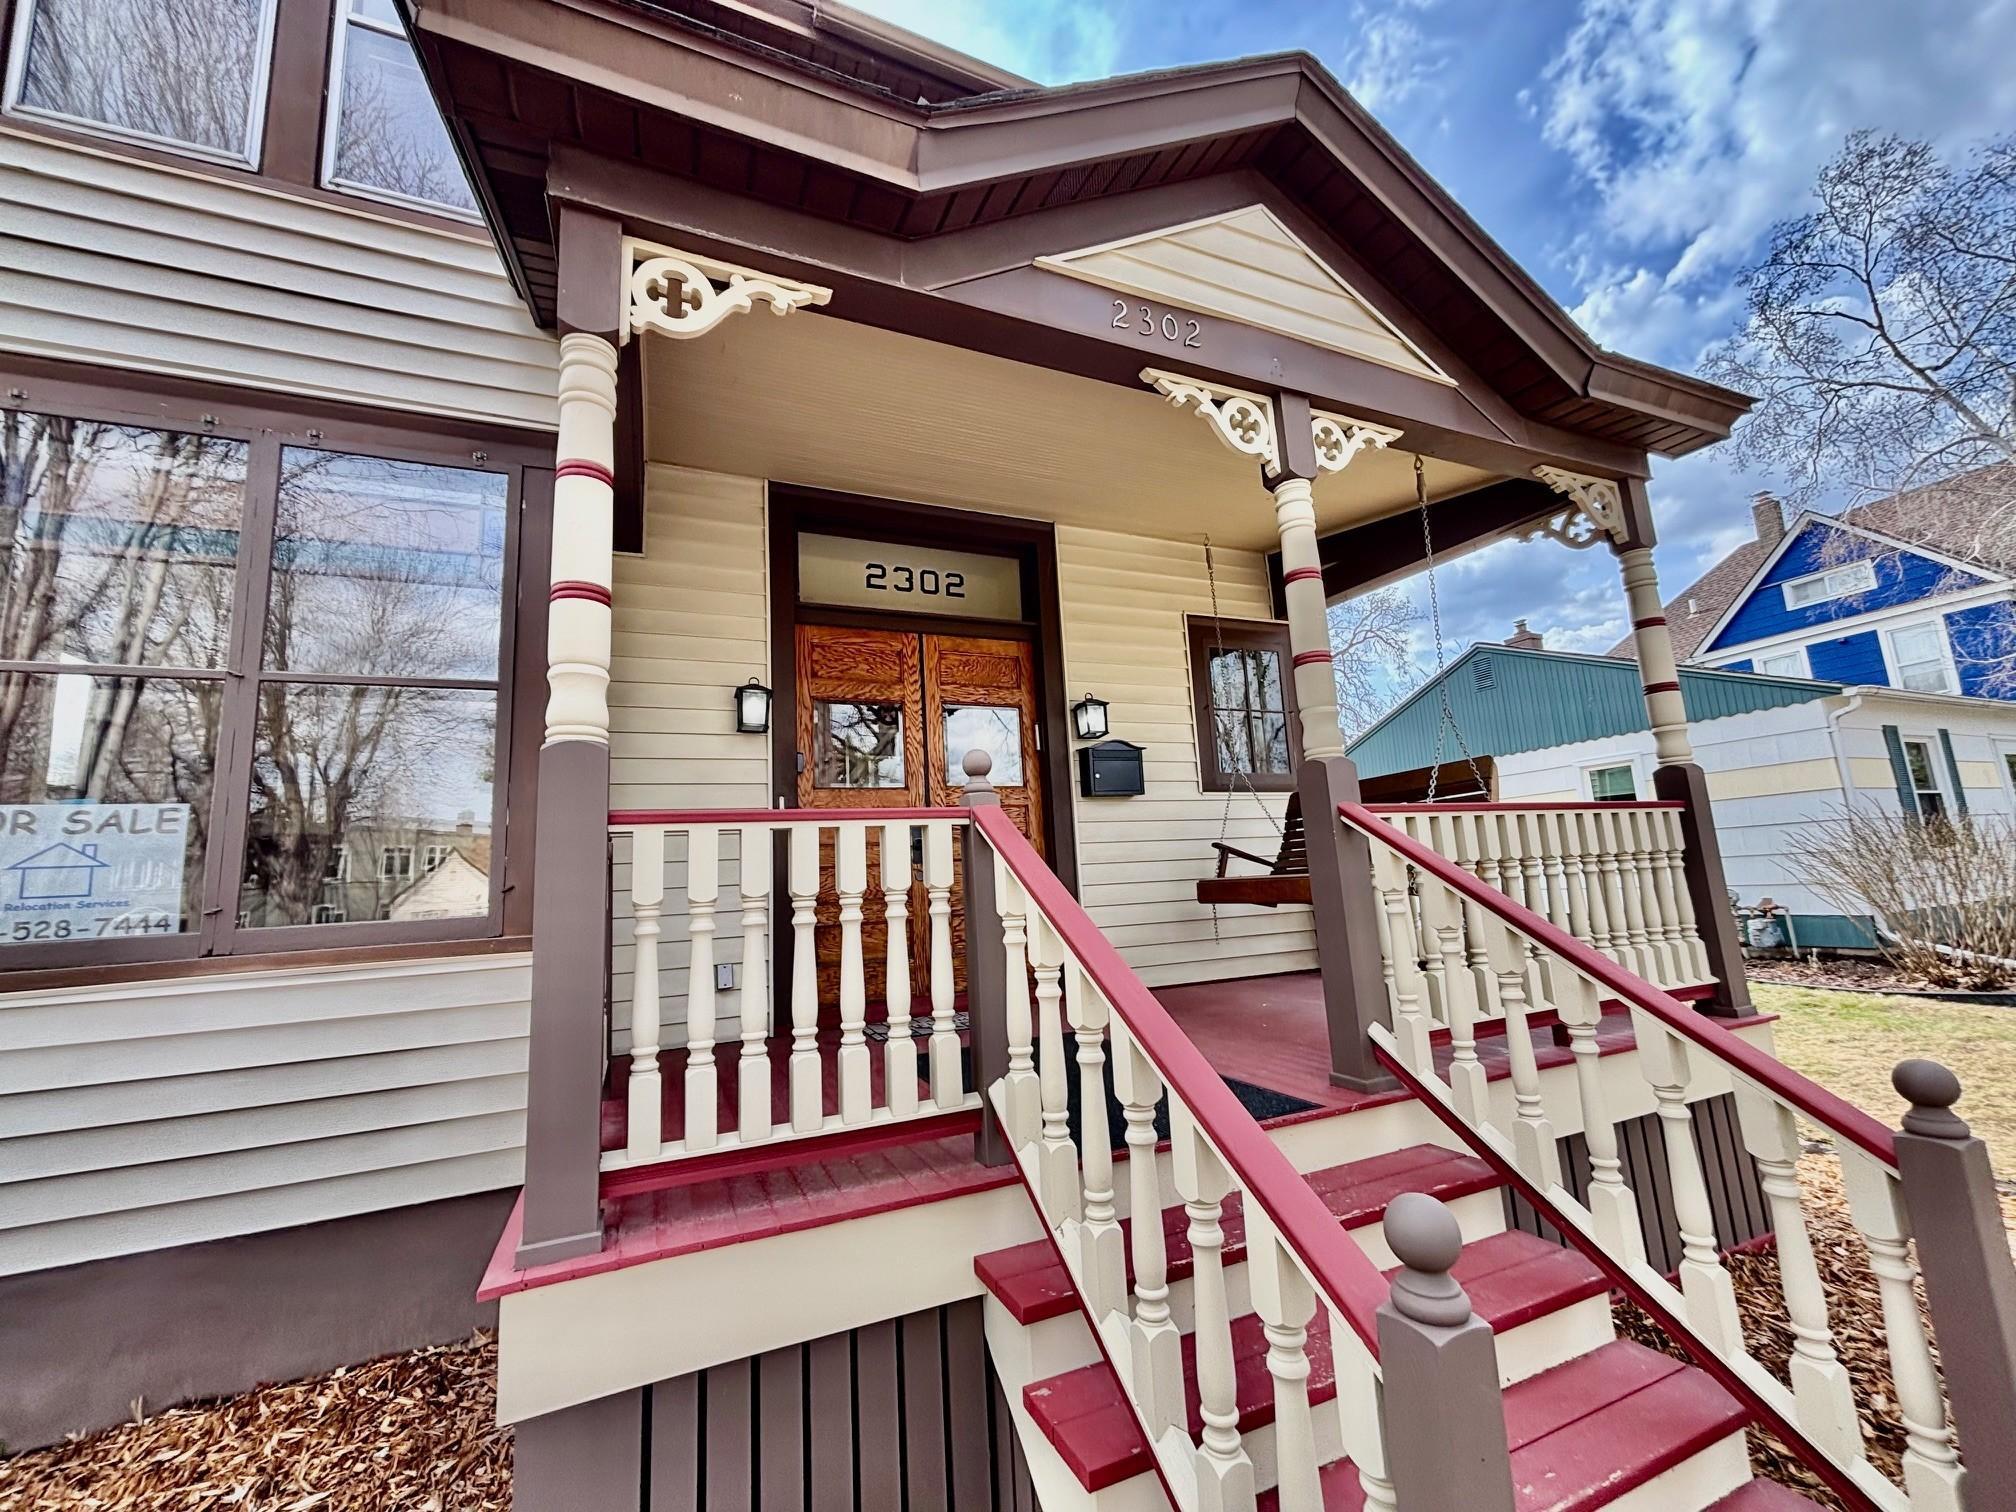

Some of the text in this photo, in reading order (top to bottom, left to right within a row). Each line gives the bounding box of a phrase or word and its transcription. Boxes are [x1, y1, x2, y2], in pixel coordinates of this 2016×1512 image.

[1111, 299, 1202, 348] 2302
[865, 562, 966, 599] 2302
[0, 806, 181, 836] R SALE
[4, 900, 130, 912] Relocation Services
